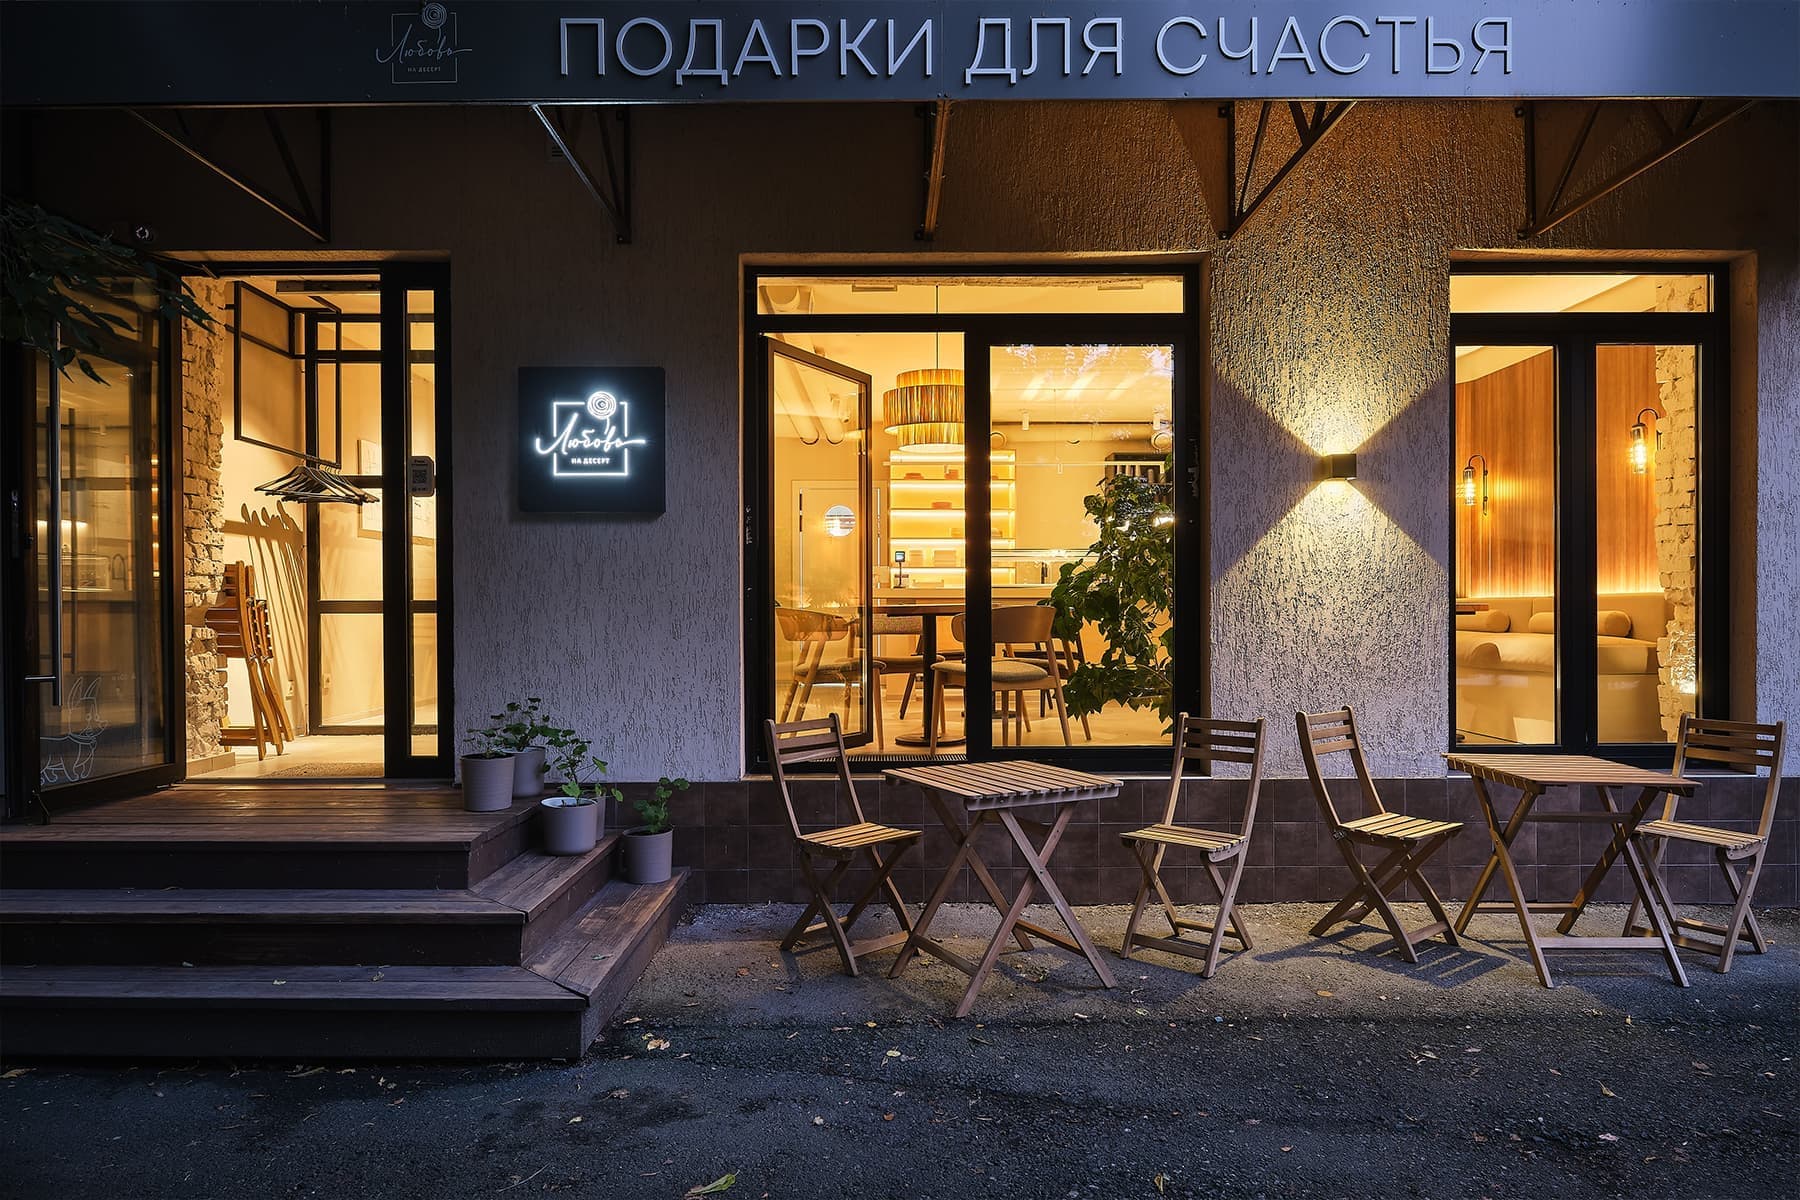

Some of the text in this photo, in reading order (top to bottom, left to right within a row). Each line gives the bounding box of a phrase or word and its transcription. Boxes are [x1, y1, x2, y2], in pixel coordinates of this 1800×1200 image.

[560, 15, 1513, 85] ПОДАРКИ ДЛЯ СЧАСТЬЯ
[570, 457, 610, 465] НА ДЕСЕРТ
